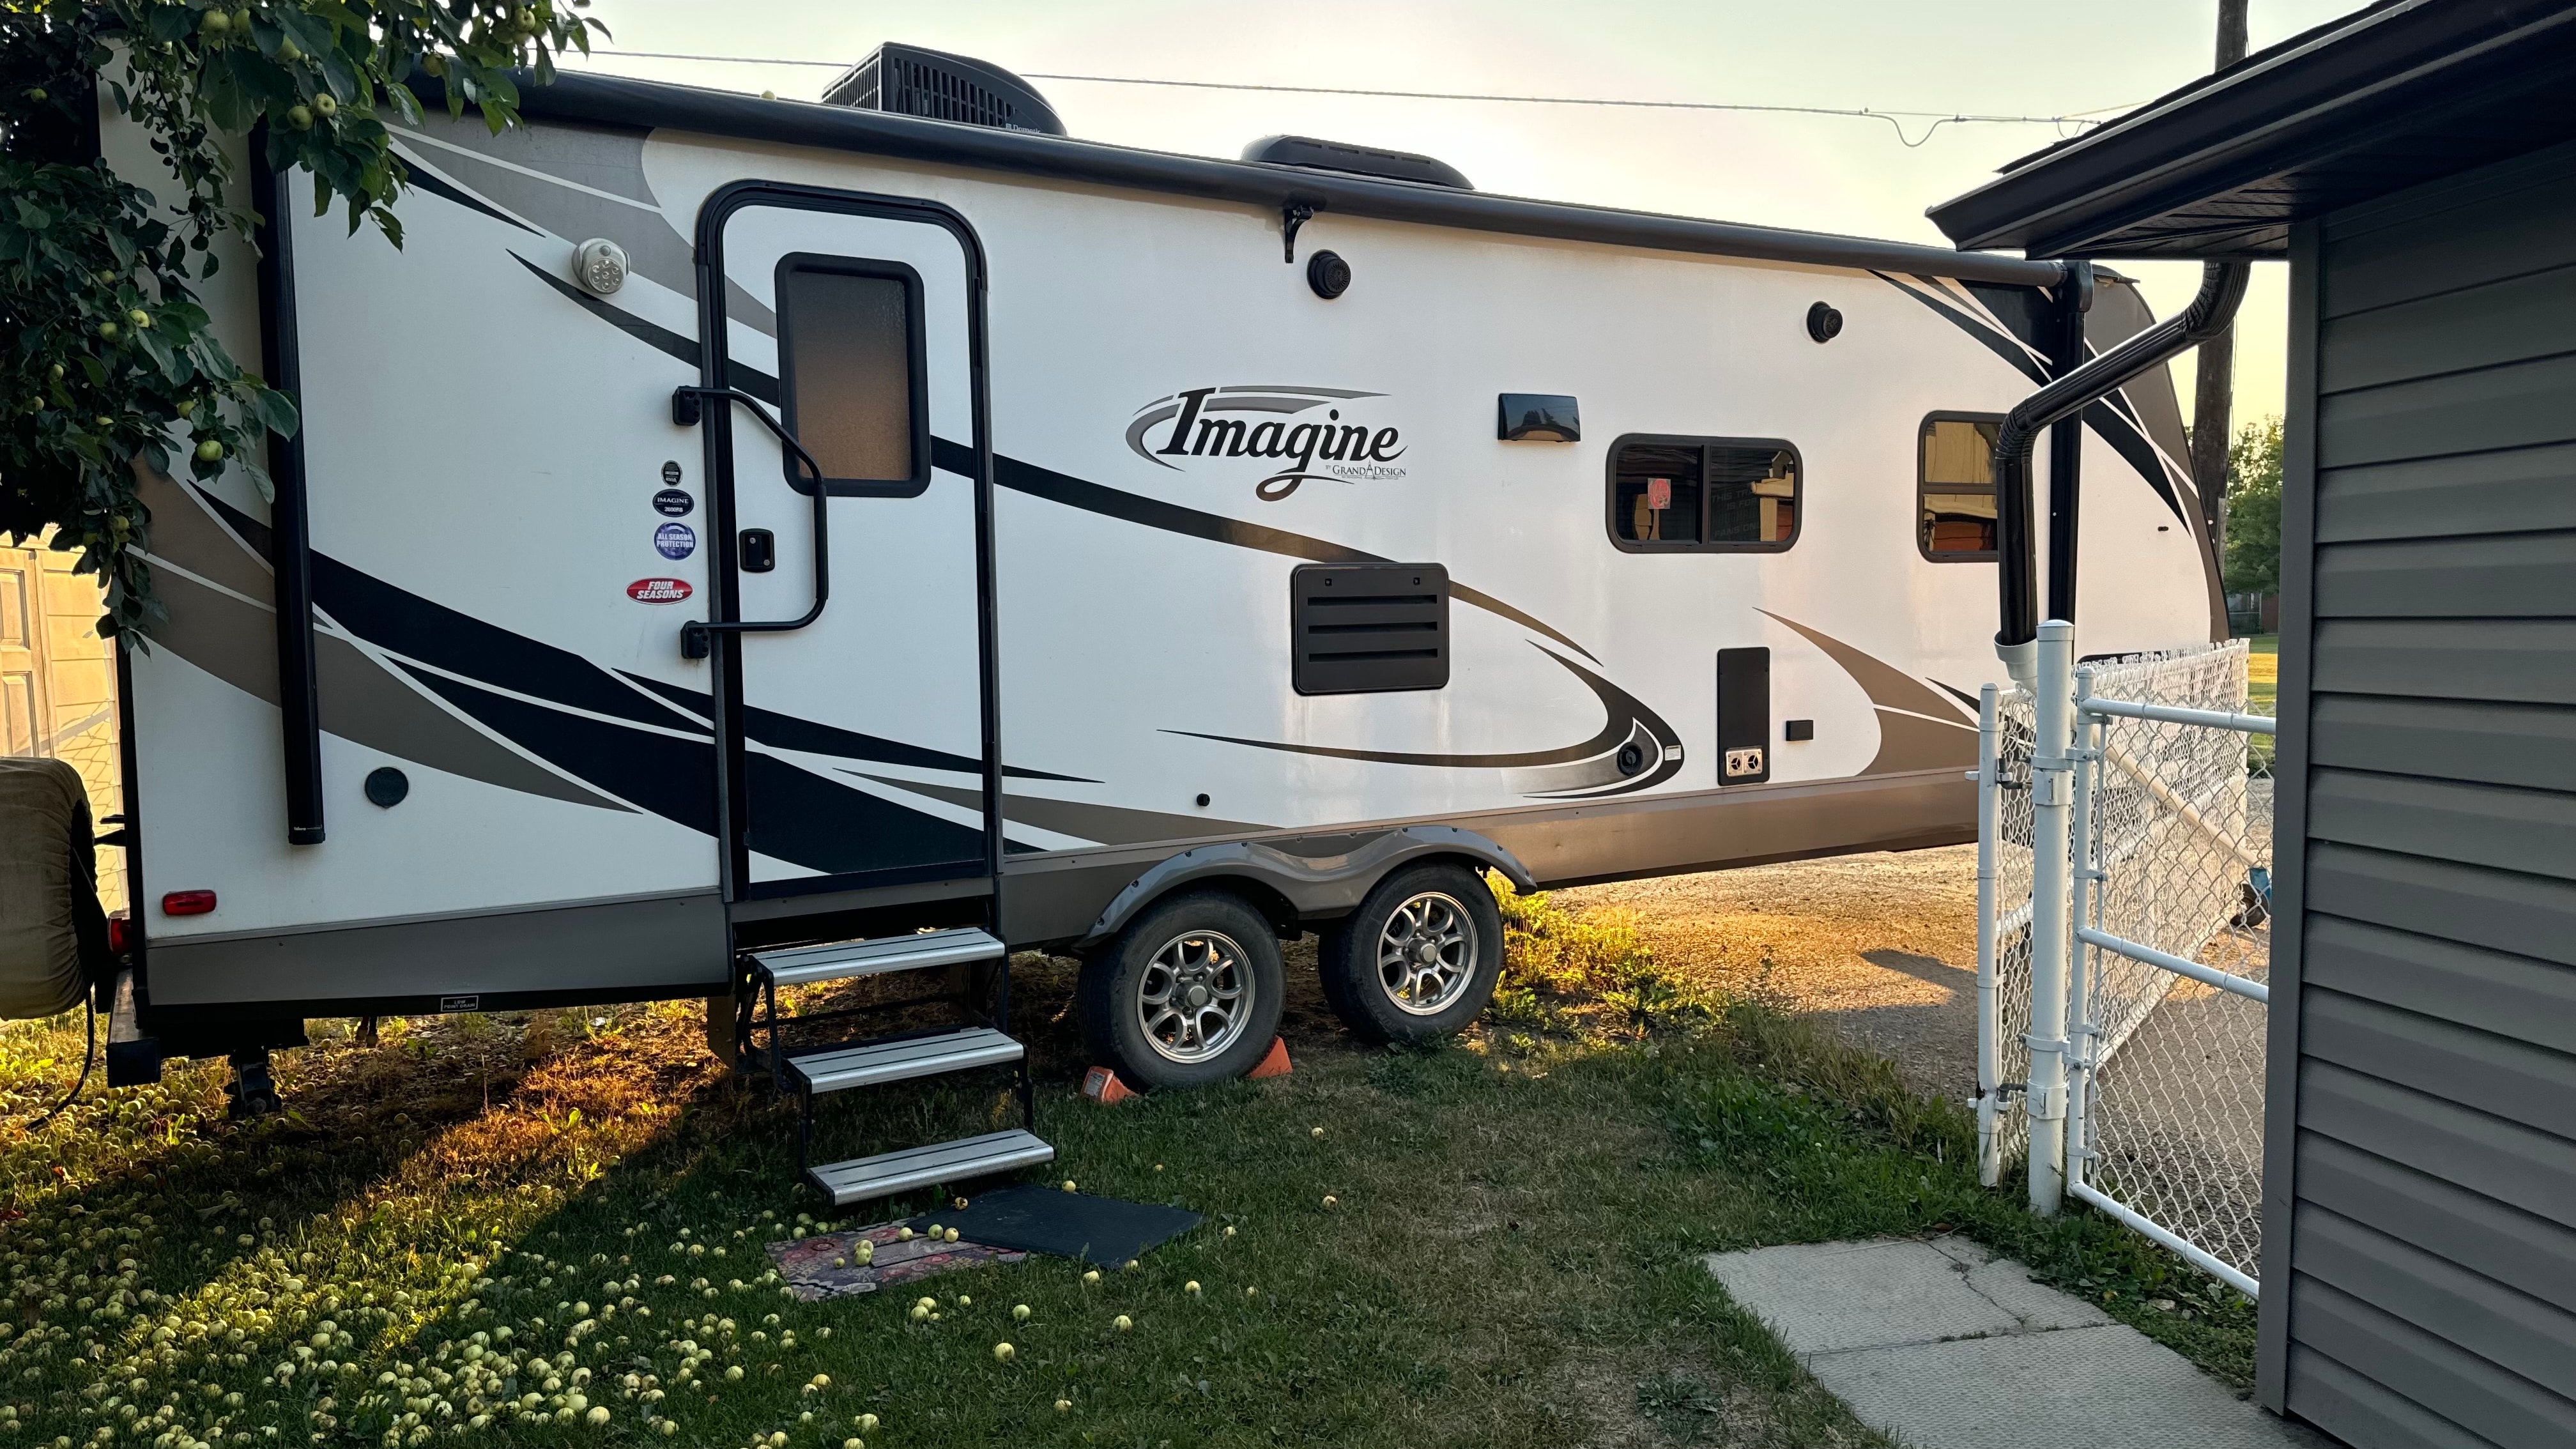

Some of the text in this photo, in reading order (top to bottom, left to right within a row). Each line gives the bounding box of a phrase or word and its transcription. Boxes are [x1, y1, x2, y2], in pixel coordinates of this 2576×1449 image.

[1156, 387, 1408, 502] Imagine
[1333, 465, 1365, 474] GRAND
[1374, 466, 1406, 476] DESIGN
[647, 581, 674, 590] FOUR
[636, 590, 684, 599] SEASONS
